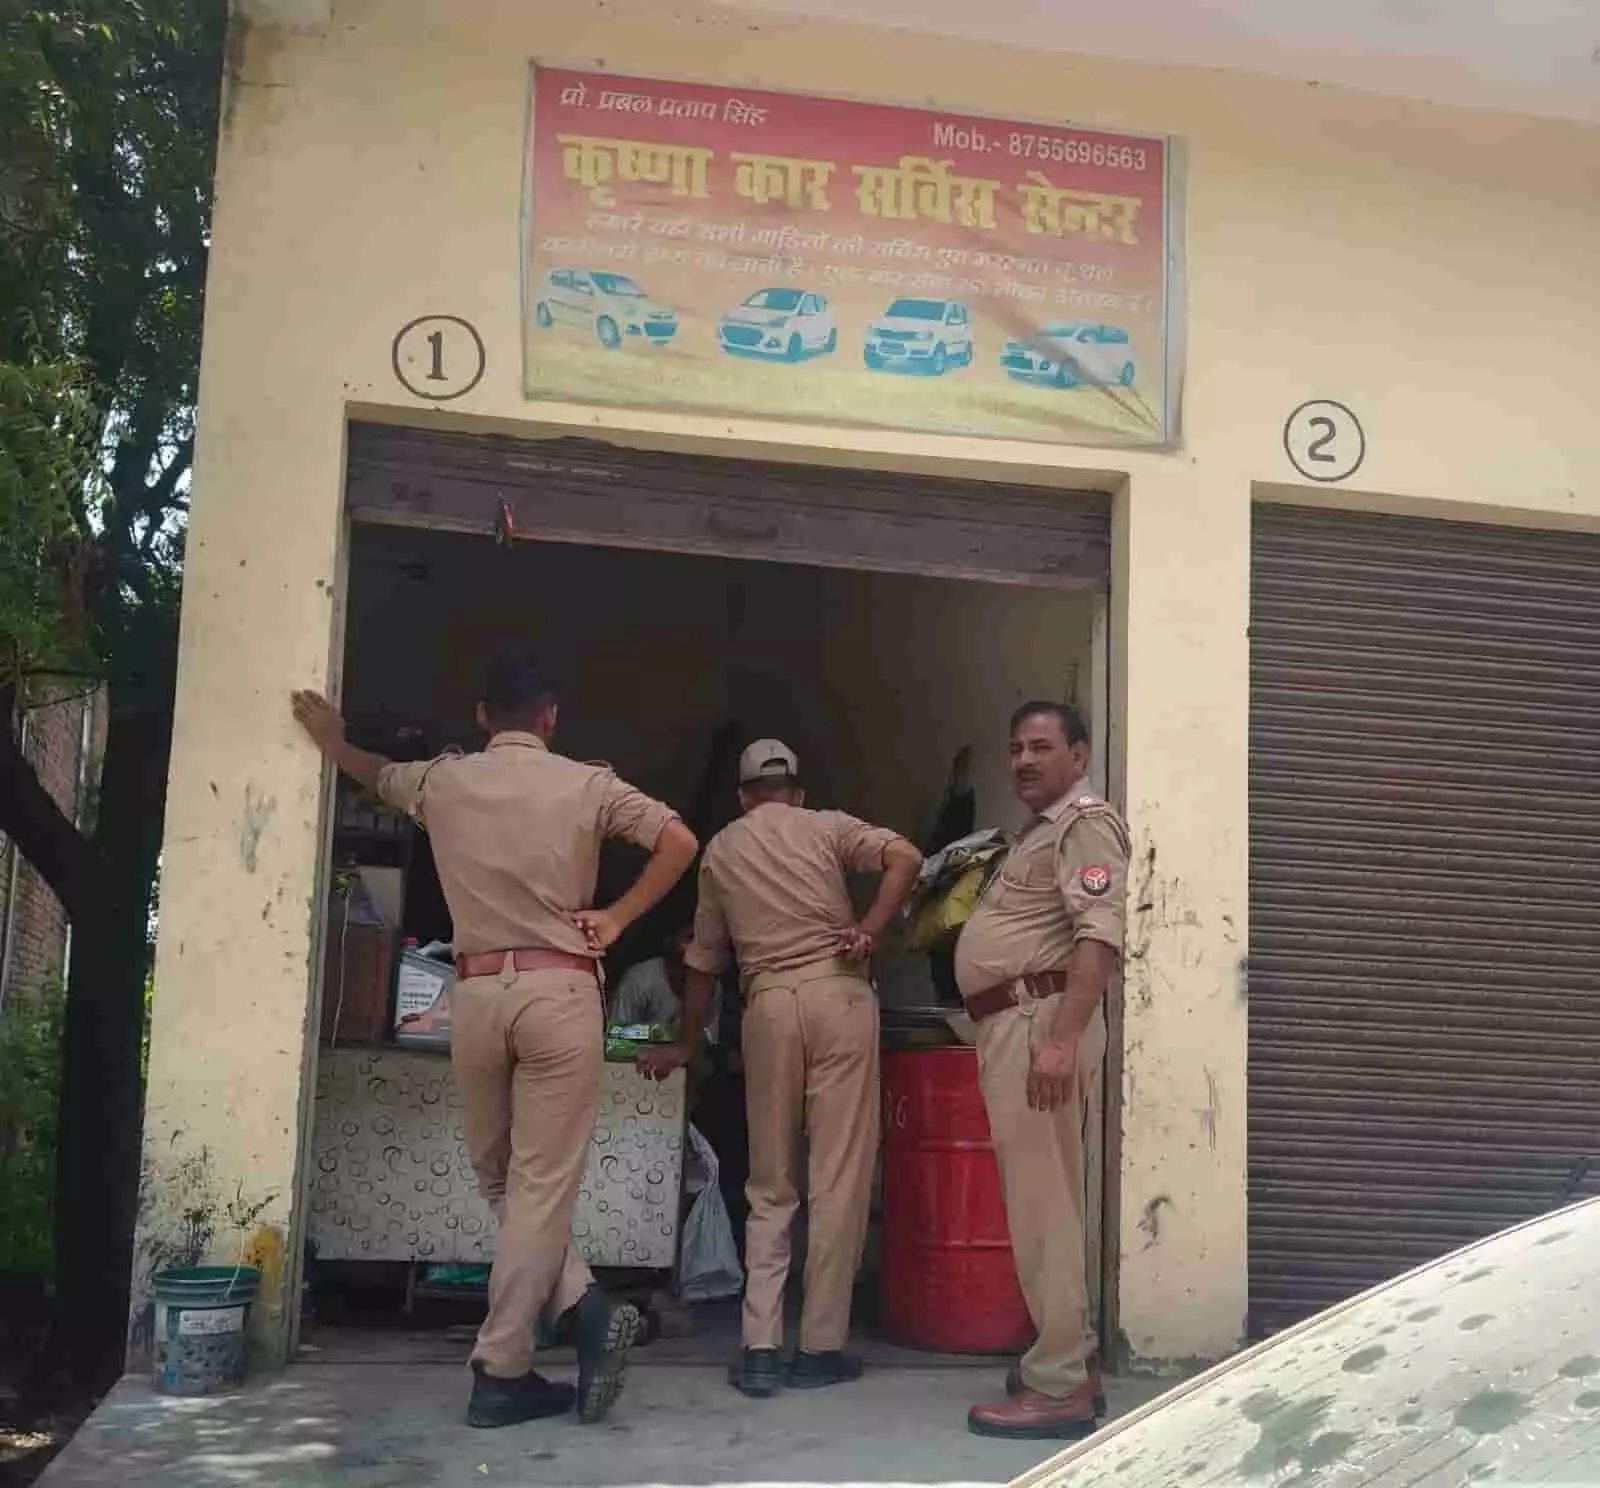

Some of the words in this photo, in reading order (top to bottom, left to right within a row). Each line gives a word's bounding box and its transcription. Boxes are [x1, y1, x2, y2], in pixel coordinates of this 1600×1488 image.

[560, 80, 591, 109] प्रो.
[596, 90, 652, 115] प्रबल
[656, 98, 717, 122] प्रताप
[722, 98, 769, 127] सिंह
[933, 121, 1001, 153] Mob.-
[1008, 131, 1147, 171] 8755696563
[556, 133, 714, 209] कृष्णा
[730, 151, 836, 212] कार
[852, 155, 1002, 230] सर्विस
[426, 331, 448, 381] 1
[1308, 416, 1336, 463] 2
